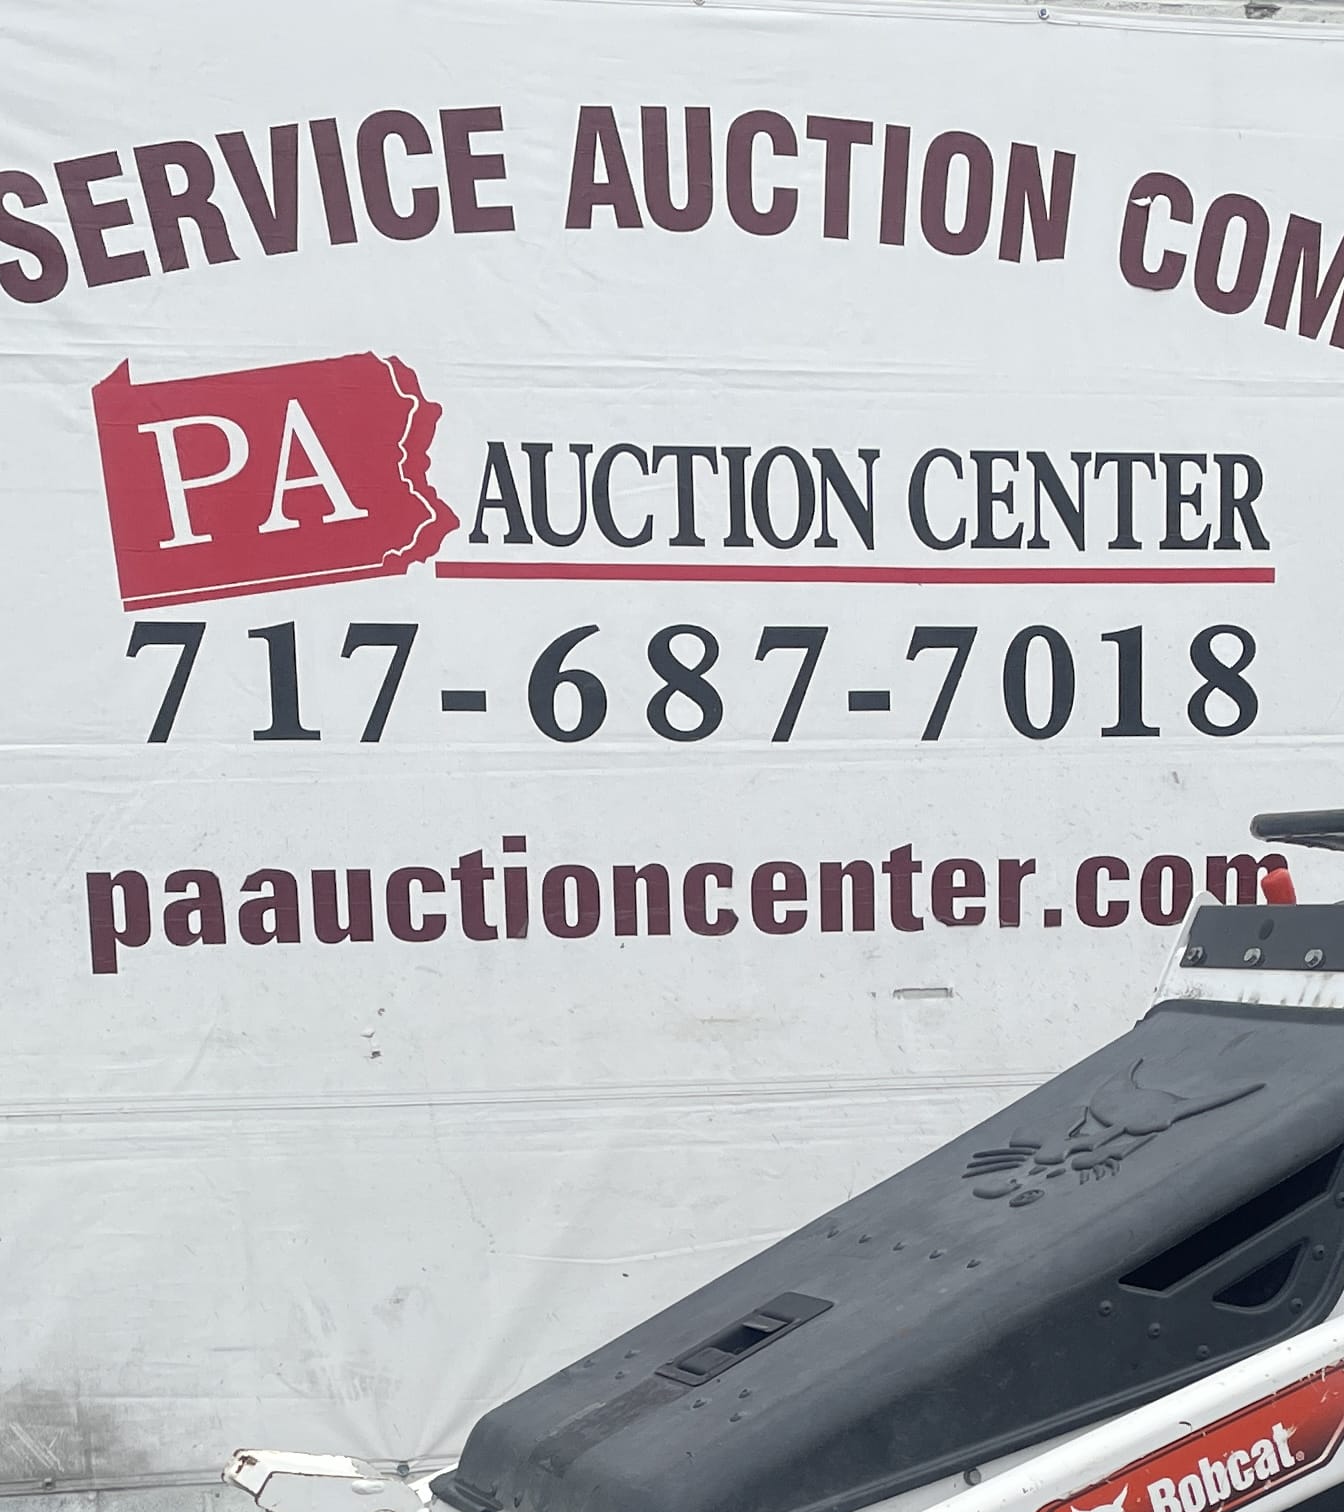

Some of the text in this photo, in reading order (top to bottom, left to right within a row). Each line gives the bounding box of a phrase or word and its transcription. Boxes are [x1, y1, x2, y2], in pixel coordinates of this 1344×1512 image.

[564, 105, 1077, 264] AUCTION
[137, 398, 1271, 551] PA AUCTION CENTER
[125, 620, 1259, 744] 717-687-7018
